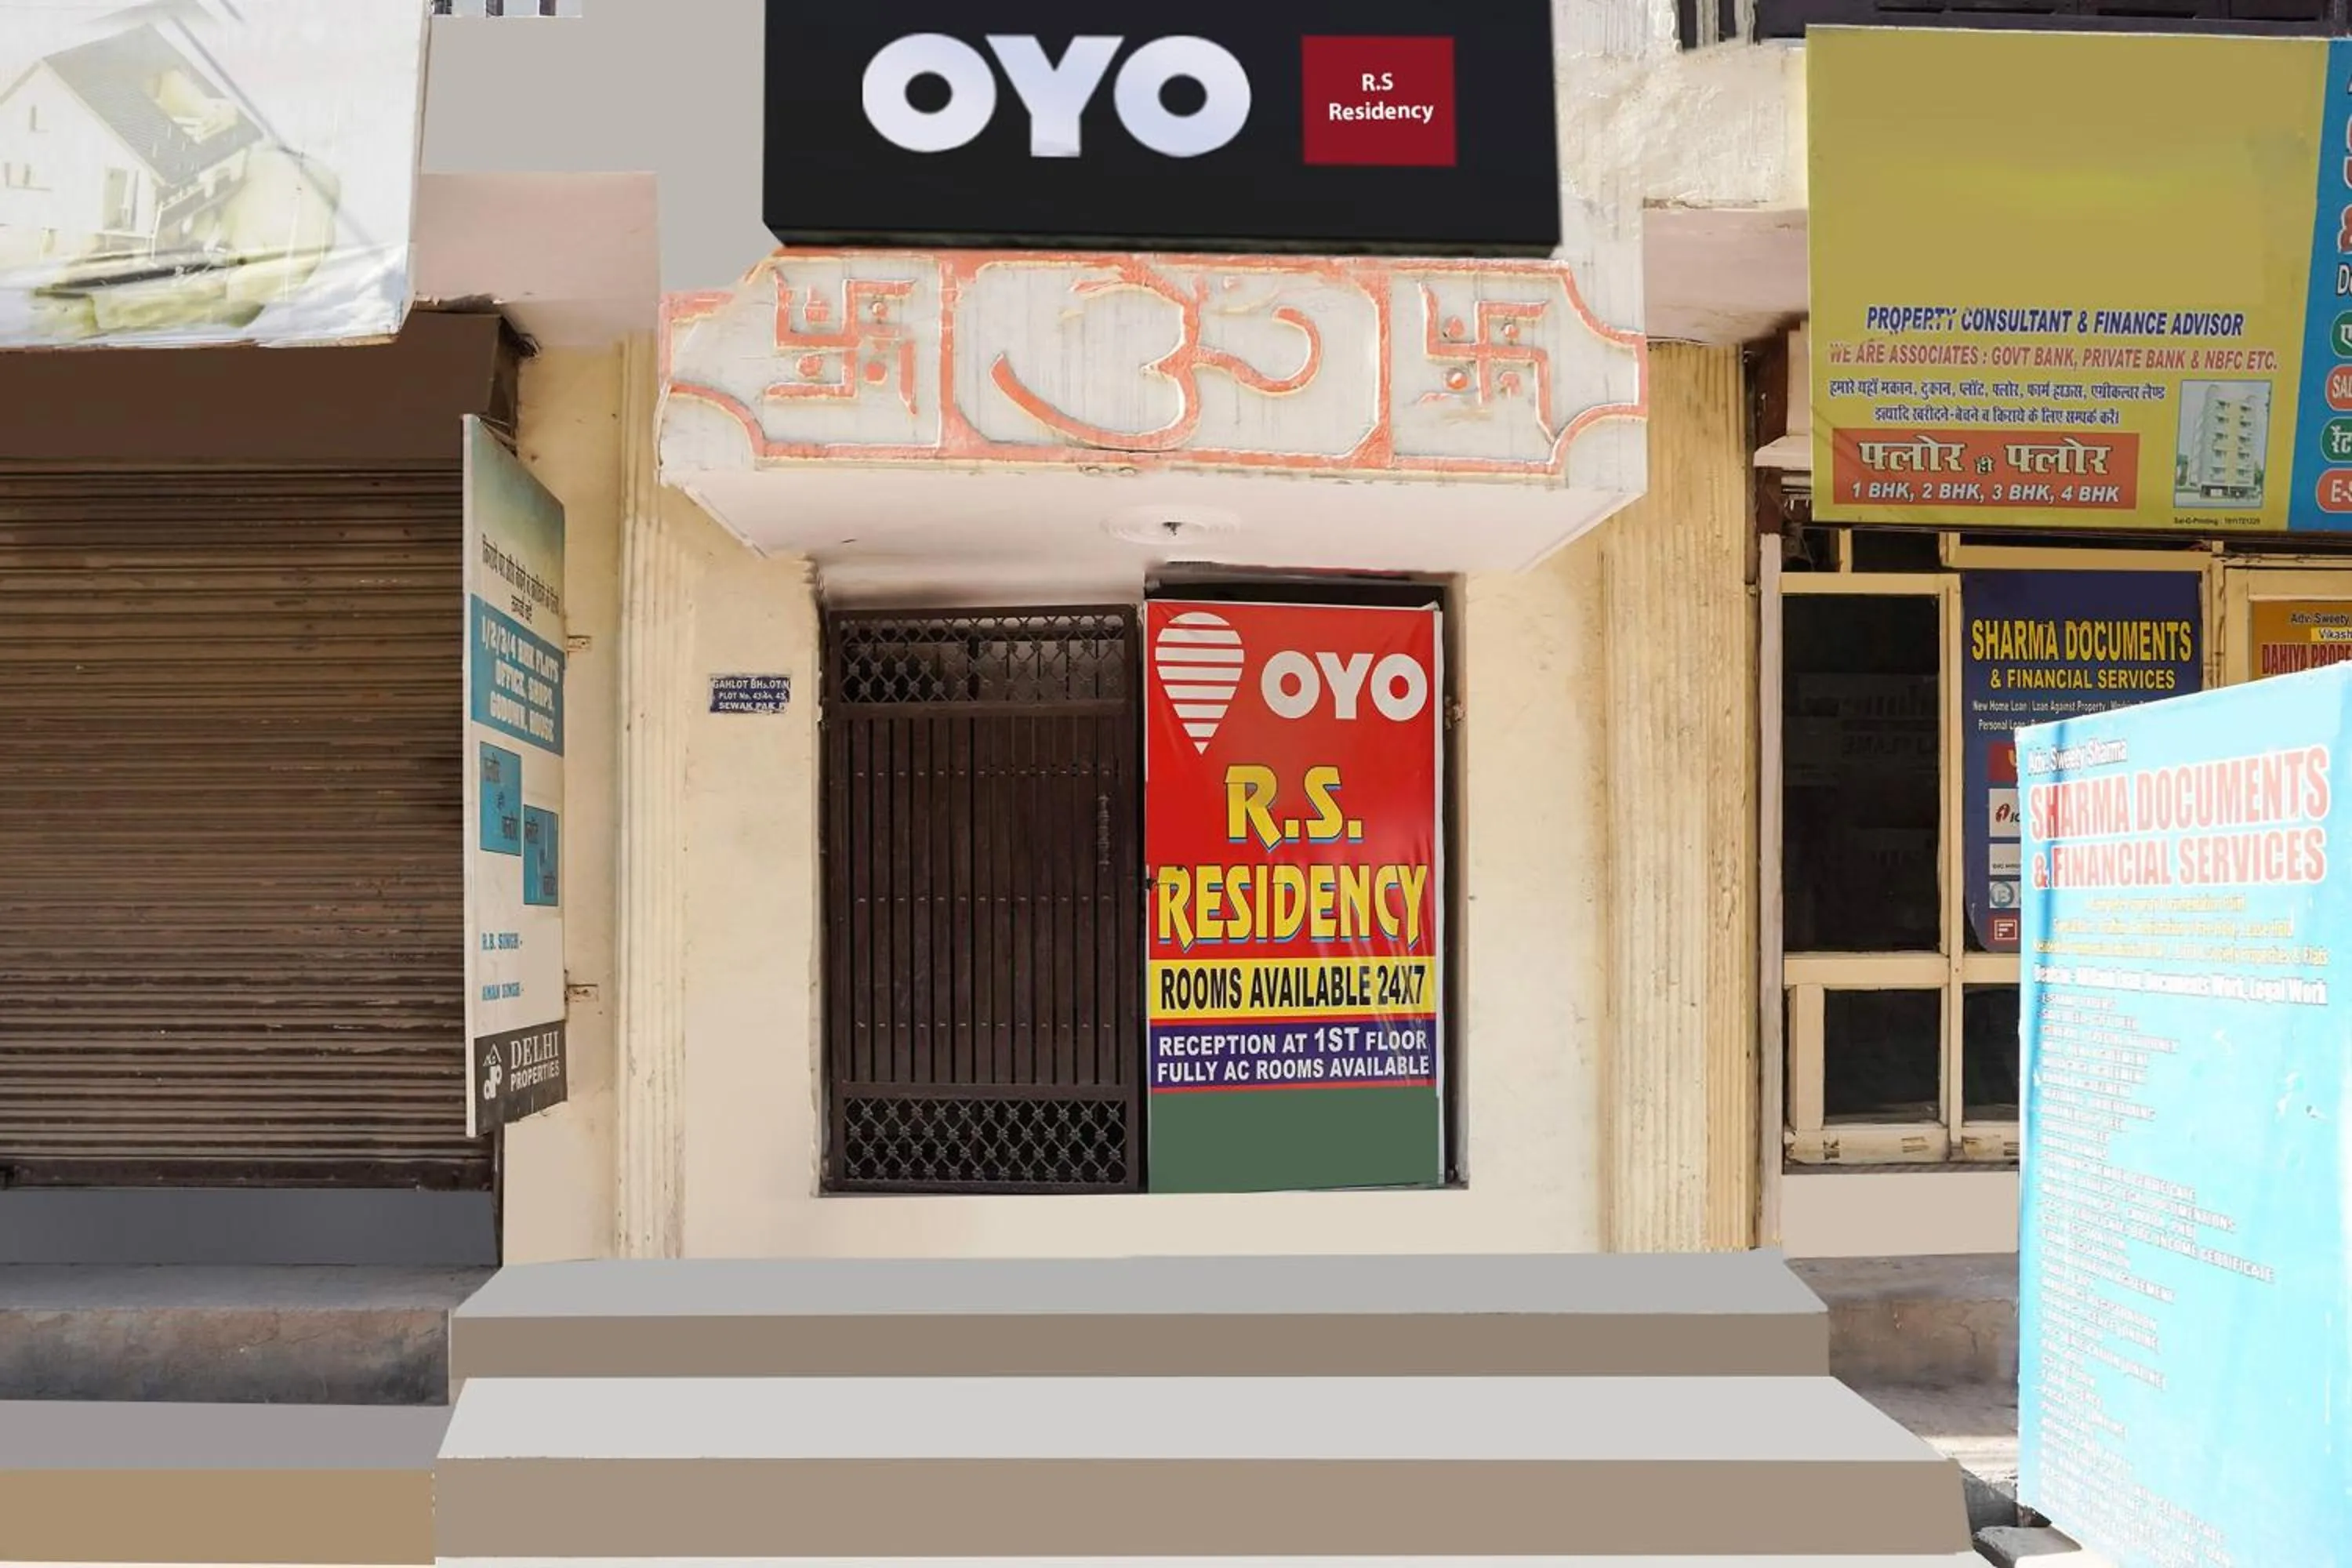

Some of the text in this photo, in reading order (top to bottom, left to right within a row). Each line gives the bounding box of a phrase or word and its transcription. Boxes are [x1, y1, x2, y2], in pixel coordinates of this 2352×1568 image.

[862, 31, 1251, 158] OYO
[1361, 73, 1395, 93] R.S
[1327, 100, 1434, 125] Residency
[1867, 307, 2245, 336] PROPERTY CONSULTANT & FINANCE ADVISOR
[1830, 343, 1851, 363] WE
[1856, 343, 1884, 364] ARE
[1889, 345, 1979, 365] ASSOCIATES
[1992, 347, 2031, 365] GOVT
[2034, 347, 2078, 372] BANK,
[2082, 348, 2143, 368] PRIVATE
[2146, 350, 2186, 369] BANK
[2190, 351, 2199, 368] &
[2204, 351, 2243, 369] NBFC
[2246, 351, 2278, 370] ETC.
[1852, 481, 2120, 504] 1 BHK, 2 BHK, 3 BHK, 4 BHK
[1971, 619, 2193, 664] SHARMA DOCUMENTS
[2262, 644, 2307, 674] DAHIYA
[713, 679, 748, 689] GAHLOT
[1260, 650, 1428, 721] OYO
[1991, 670, 2176, 690] & FINANCIAL SERVICES
[1973, 700, 1987, 712] New
[1988, 700, 2009, 712] Home
[2010, 701, 2028, 713] Loan
[2032, 701, 2048, 713] Loan
[2049, 700, 2075, 714] Against
[2078, 700, 2107, 715] Property
[1978, 719, 2007, 731] Personal
[1225, 764, 1364, 852] R.S.
[2030, 746, 2328, 840] SHARMA DOCUMENTS
[2034, 827, 2325, 888] & FINANCIAL SERVICES
[1157, 865, 1428, 953] RESIDENCY
[1160, 964, 1426, 1011] ROOMS AVAILABLE 24X7
[510, 1031, 559, 1071] DELHI
[1159, 1027, 1427, 1057] RECEPTION AT 1ST FLOOR
[510, 1059, 560, 1093] PROPERTIES
[1157, 1054, 1429, 1083] FULLY AC ROOMS AVAILABLE
